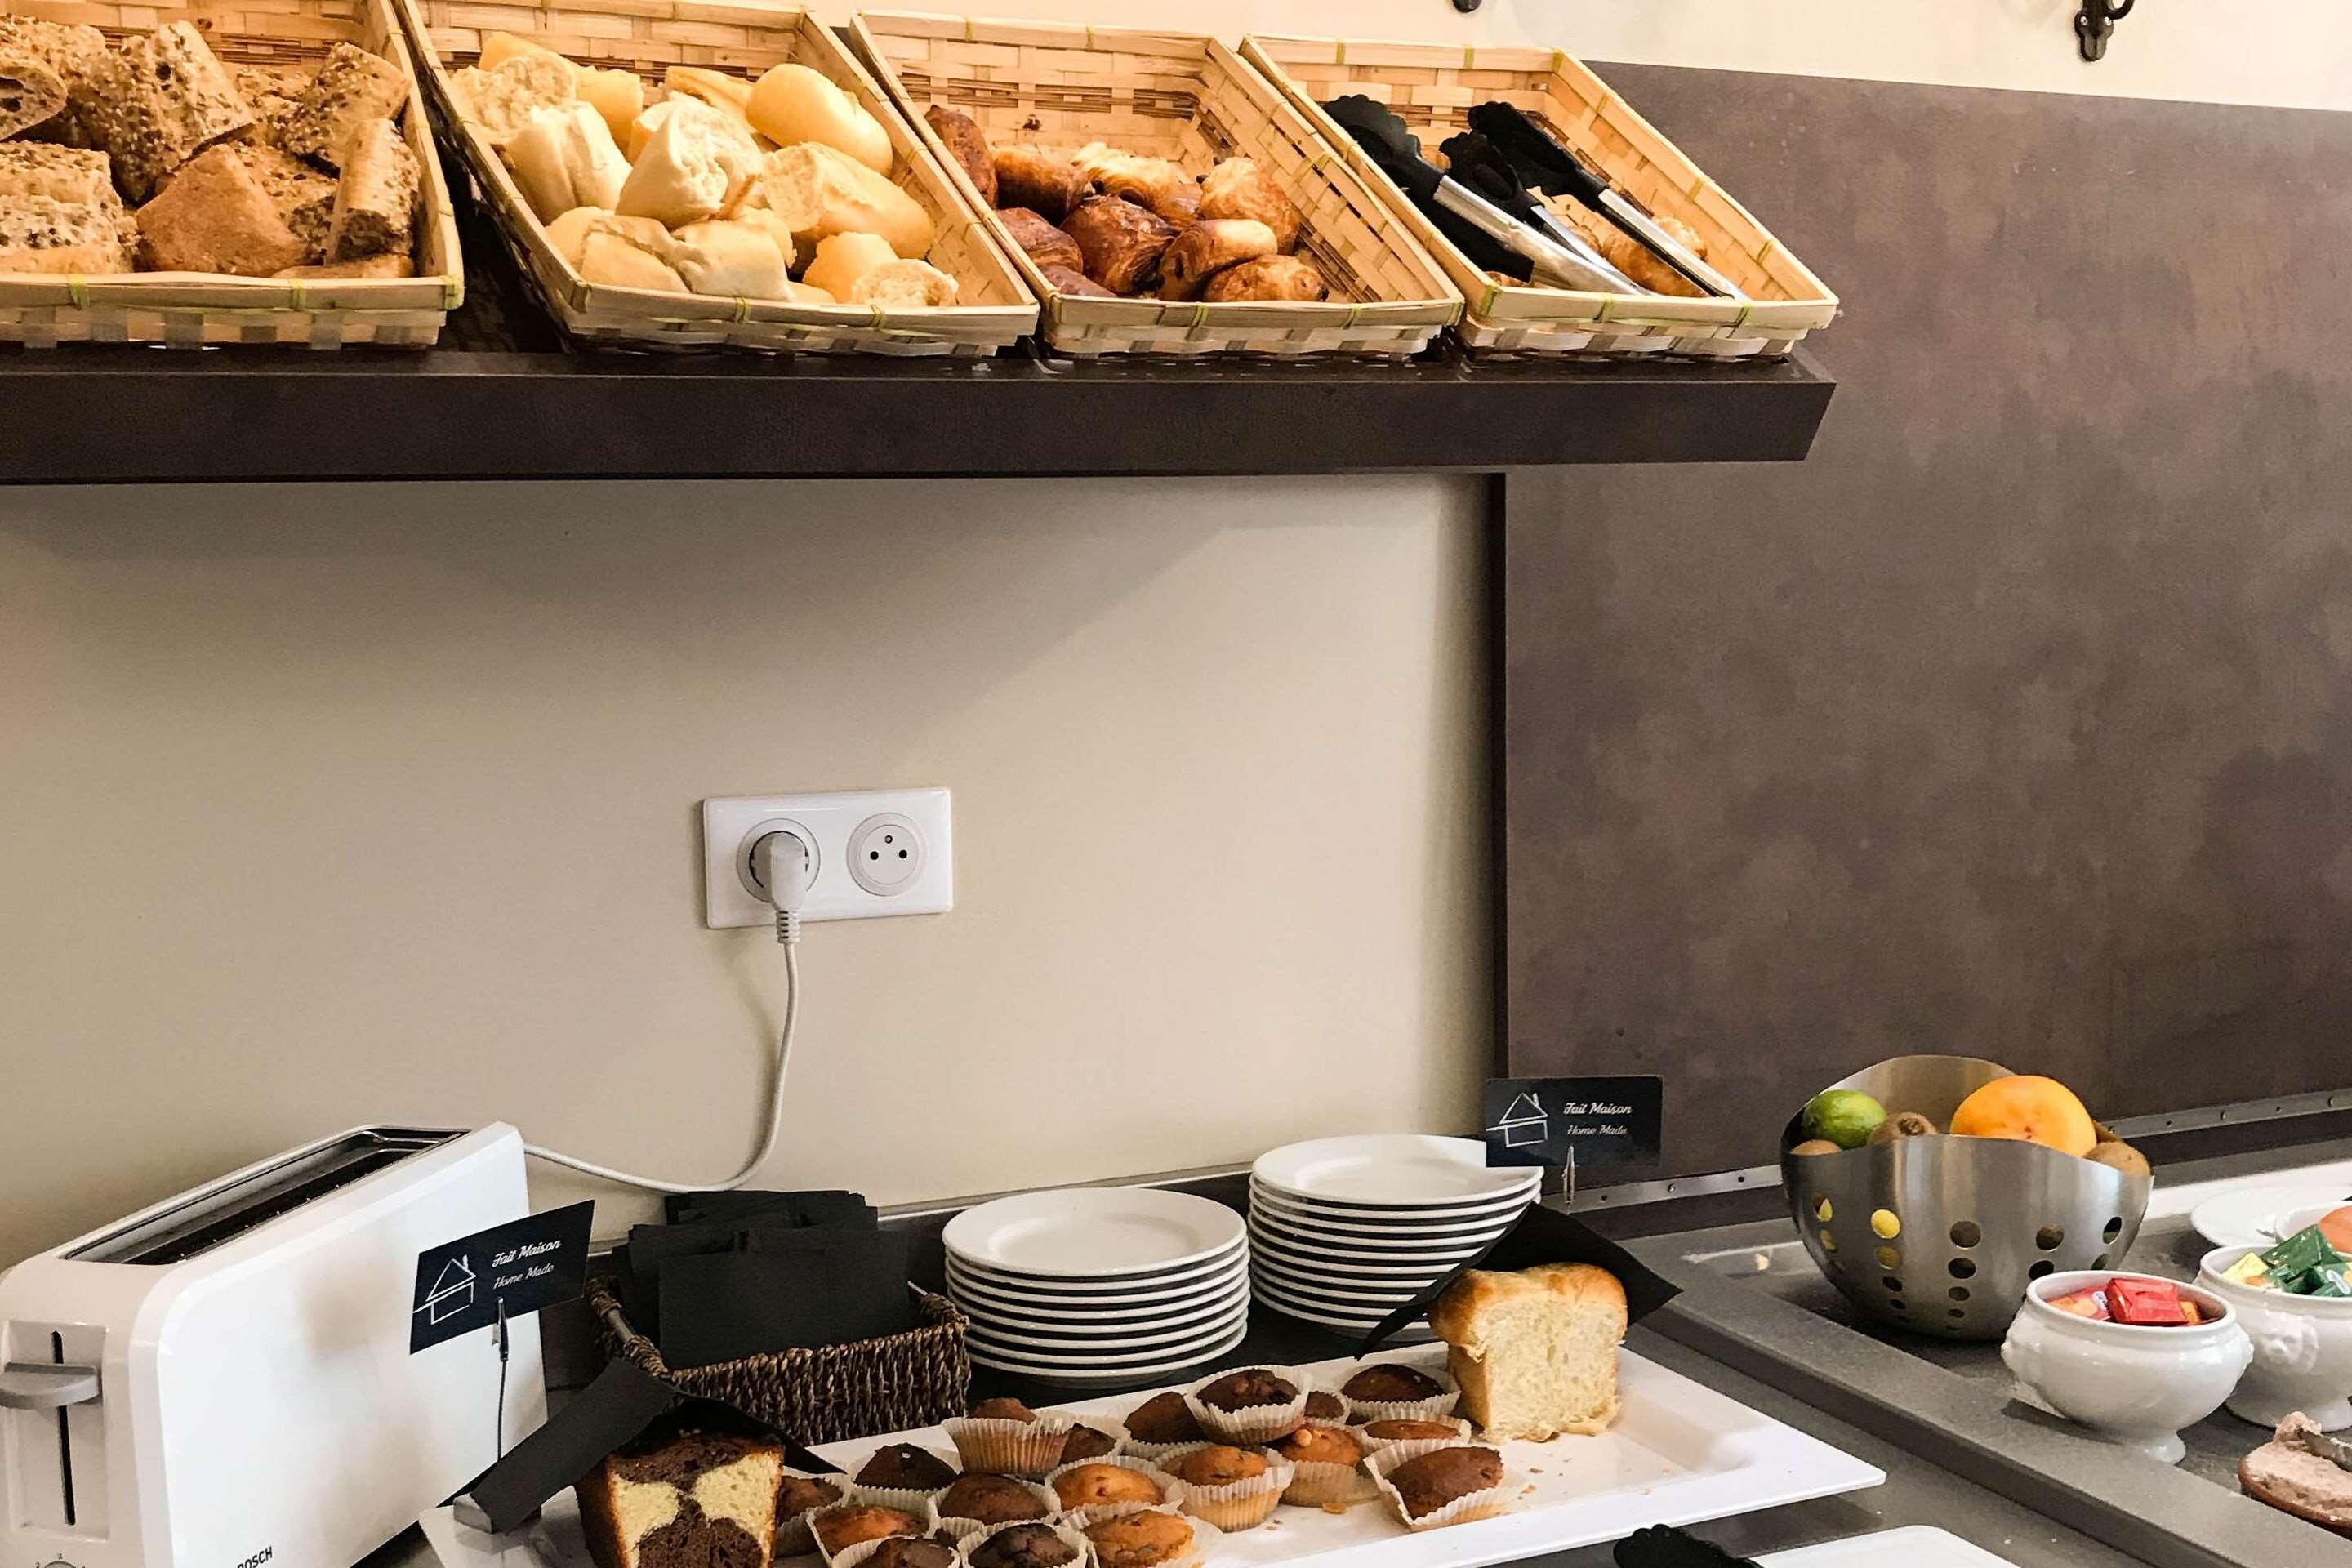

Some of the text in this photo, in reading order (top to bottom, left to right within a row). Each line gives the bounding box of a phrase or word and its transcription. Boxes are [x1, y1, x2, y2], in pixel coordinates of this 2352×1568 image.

[1563, 1102, 1633, 1115] Fait Maison
[1567, 1124, 1628, 1135] Home Made
[492, 1240, 562, 1267] Fait Maison
[492, 1263, 555, 1290] Home Made
